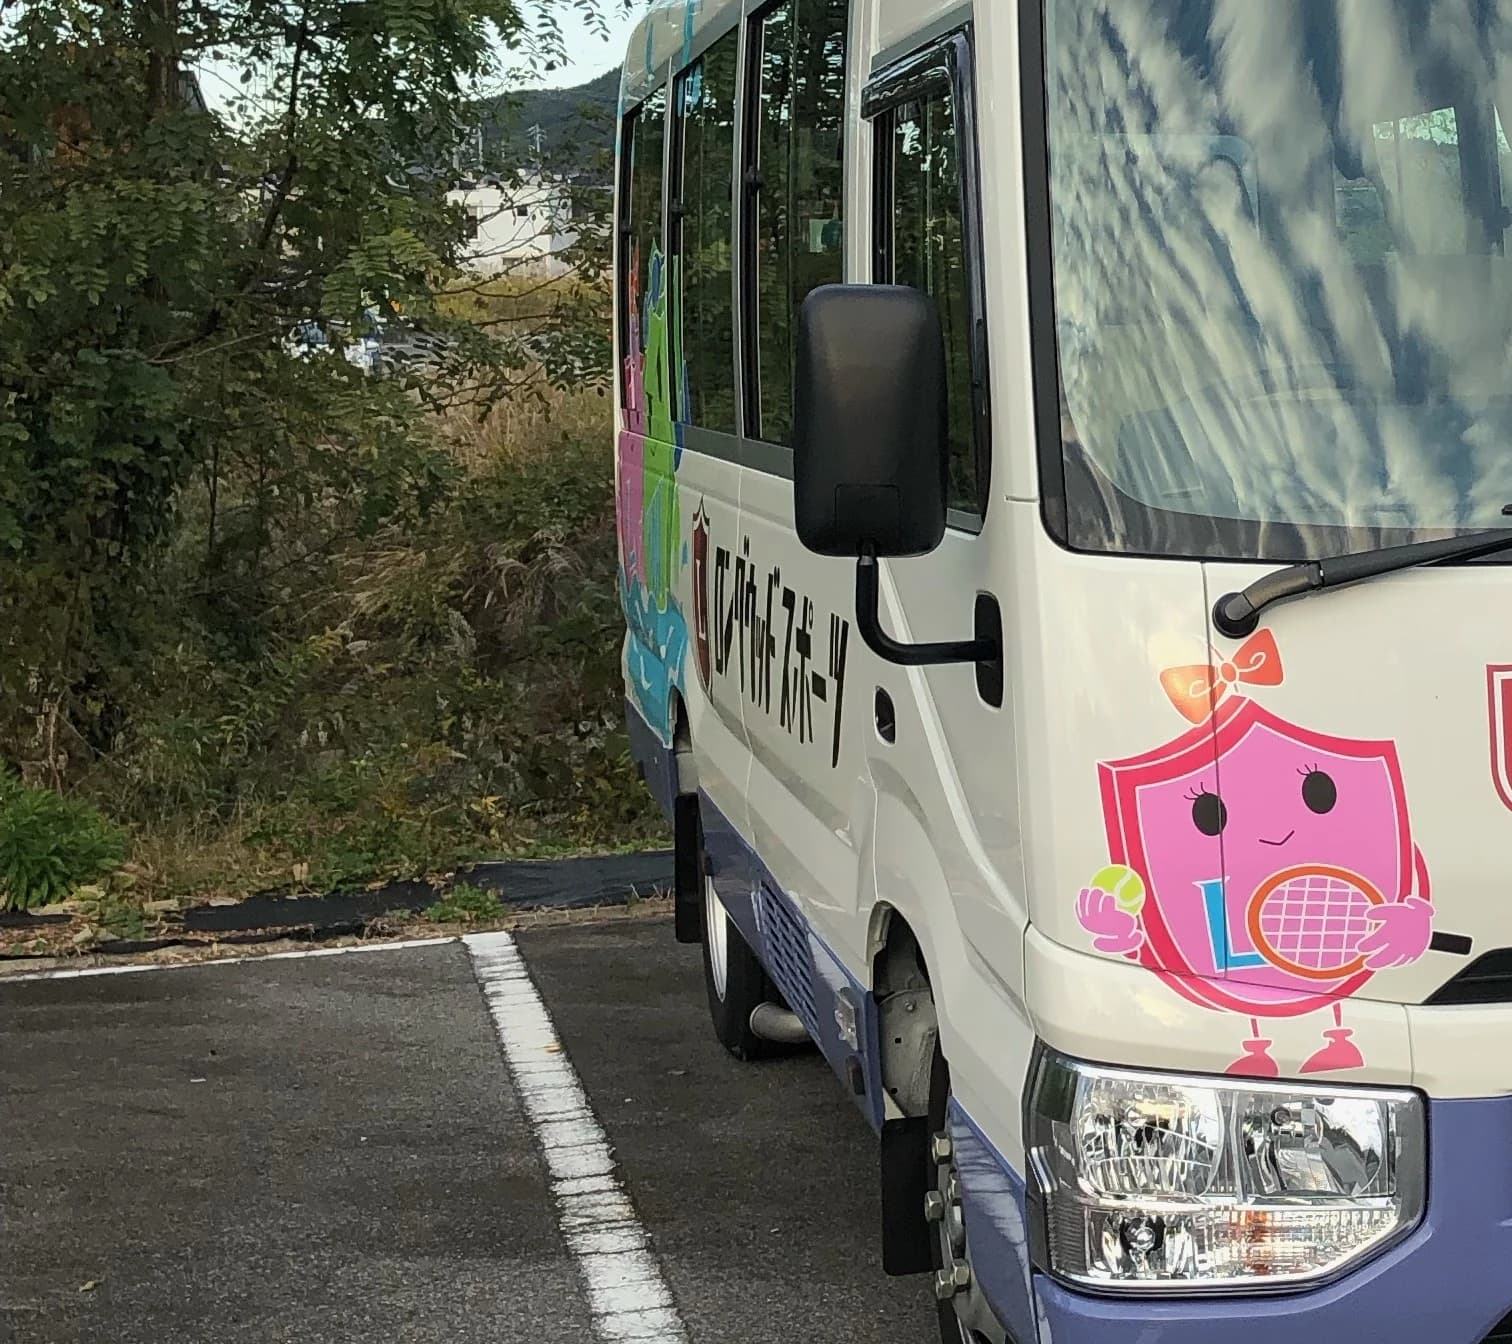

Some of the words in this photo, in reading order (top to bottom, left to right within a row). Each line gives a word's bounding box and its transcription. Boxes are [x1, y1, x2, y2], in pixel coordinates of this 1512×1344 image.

[714, 534, 850, 769] ロングウッドスポーツ
